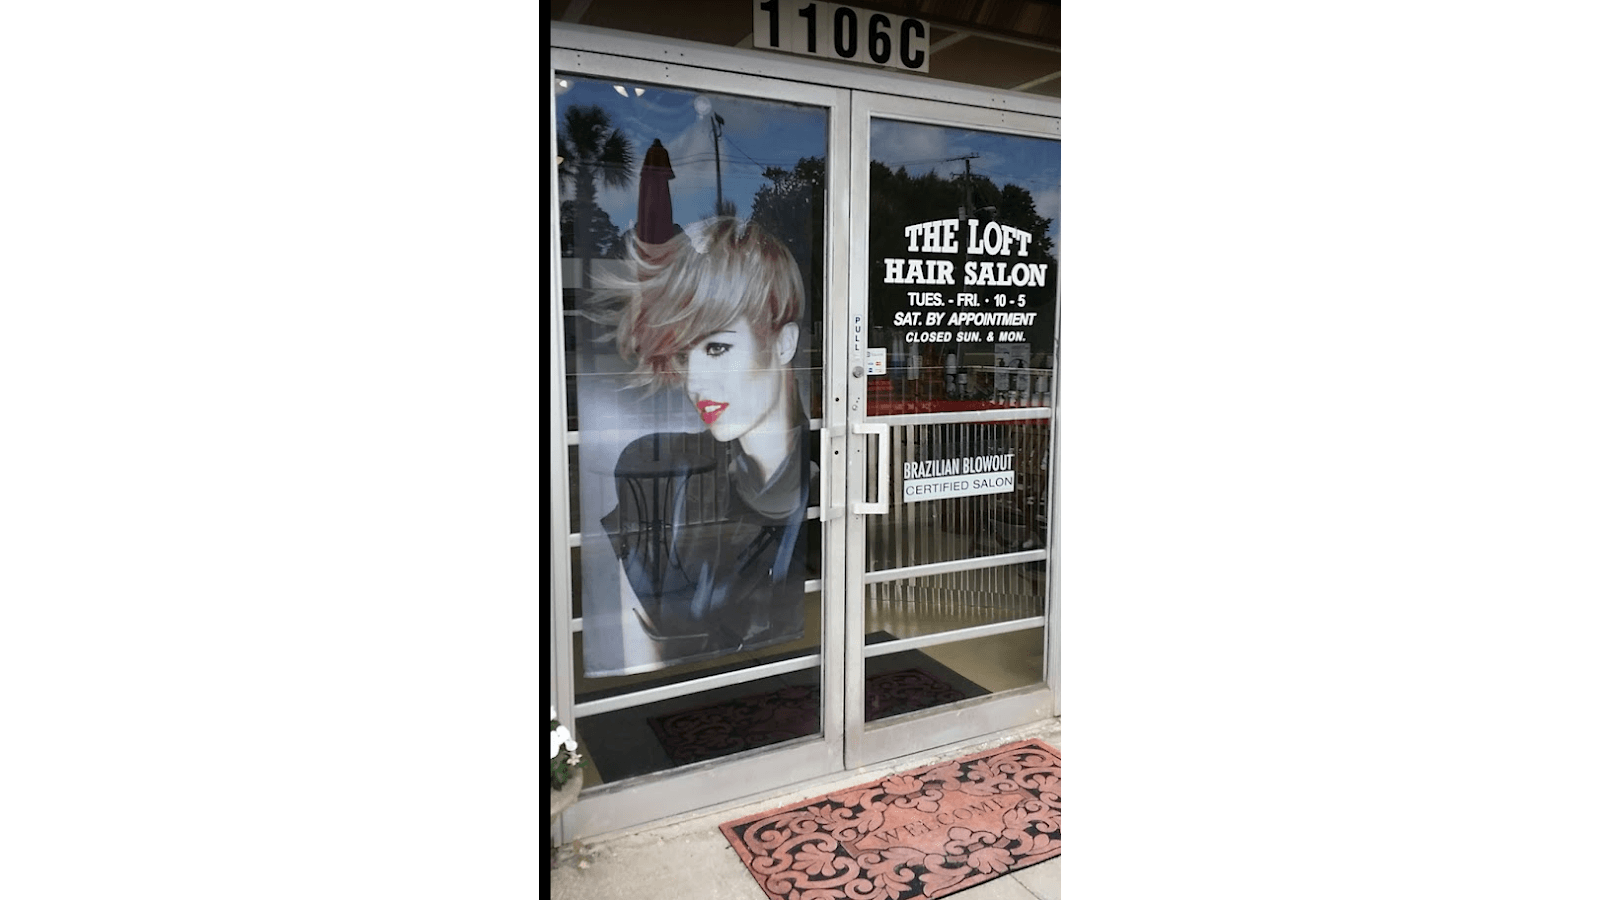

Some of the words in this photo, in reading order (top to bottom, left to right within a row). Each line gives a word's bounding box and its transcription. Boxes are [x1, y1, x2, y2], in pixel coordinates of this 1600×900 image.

[760, 1, 926, 69] 1106C
[905, 218, 959, 253] THE
[967, 218, 1032, 257] LOFT
[884, 258, 955, 284] HAIR
[964, 261, 1048, 287] SALON
[907, 292, 945, 306] TUES.
[956, 293, 980, 307] FRI.
[994, 294, 1006, 307] 10
[1017, 294, 1026, 307] 5
[893, 312, 922, 326] SAT.
[925, 312, 945, 326] BY
[947, 312, 1037, 326] APPOINTMENT
[905, 331, 952, 343] CLOSED
[955, 331, 982, 343] SUN.
[986, 331, 994, 342] &
[998, 331, 1026, 342] MON.
[903, 458, 960, 479] BRAZILIAN
[962, 454, 1015, 474] BLOWOUT
[905, 480, 969, 496] CERTIFIED
[972, 476, 1013, 490] SALON
